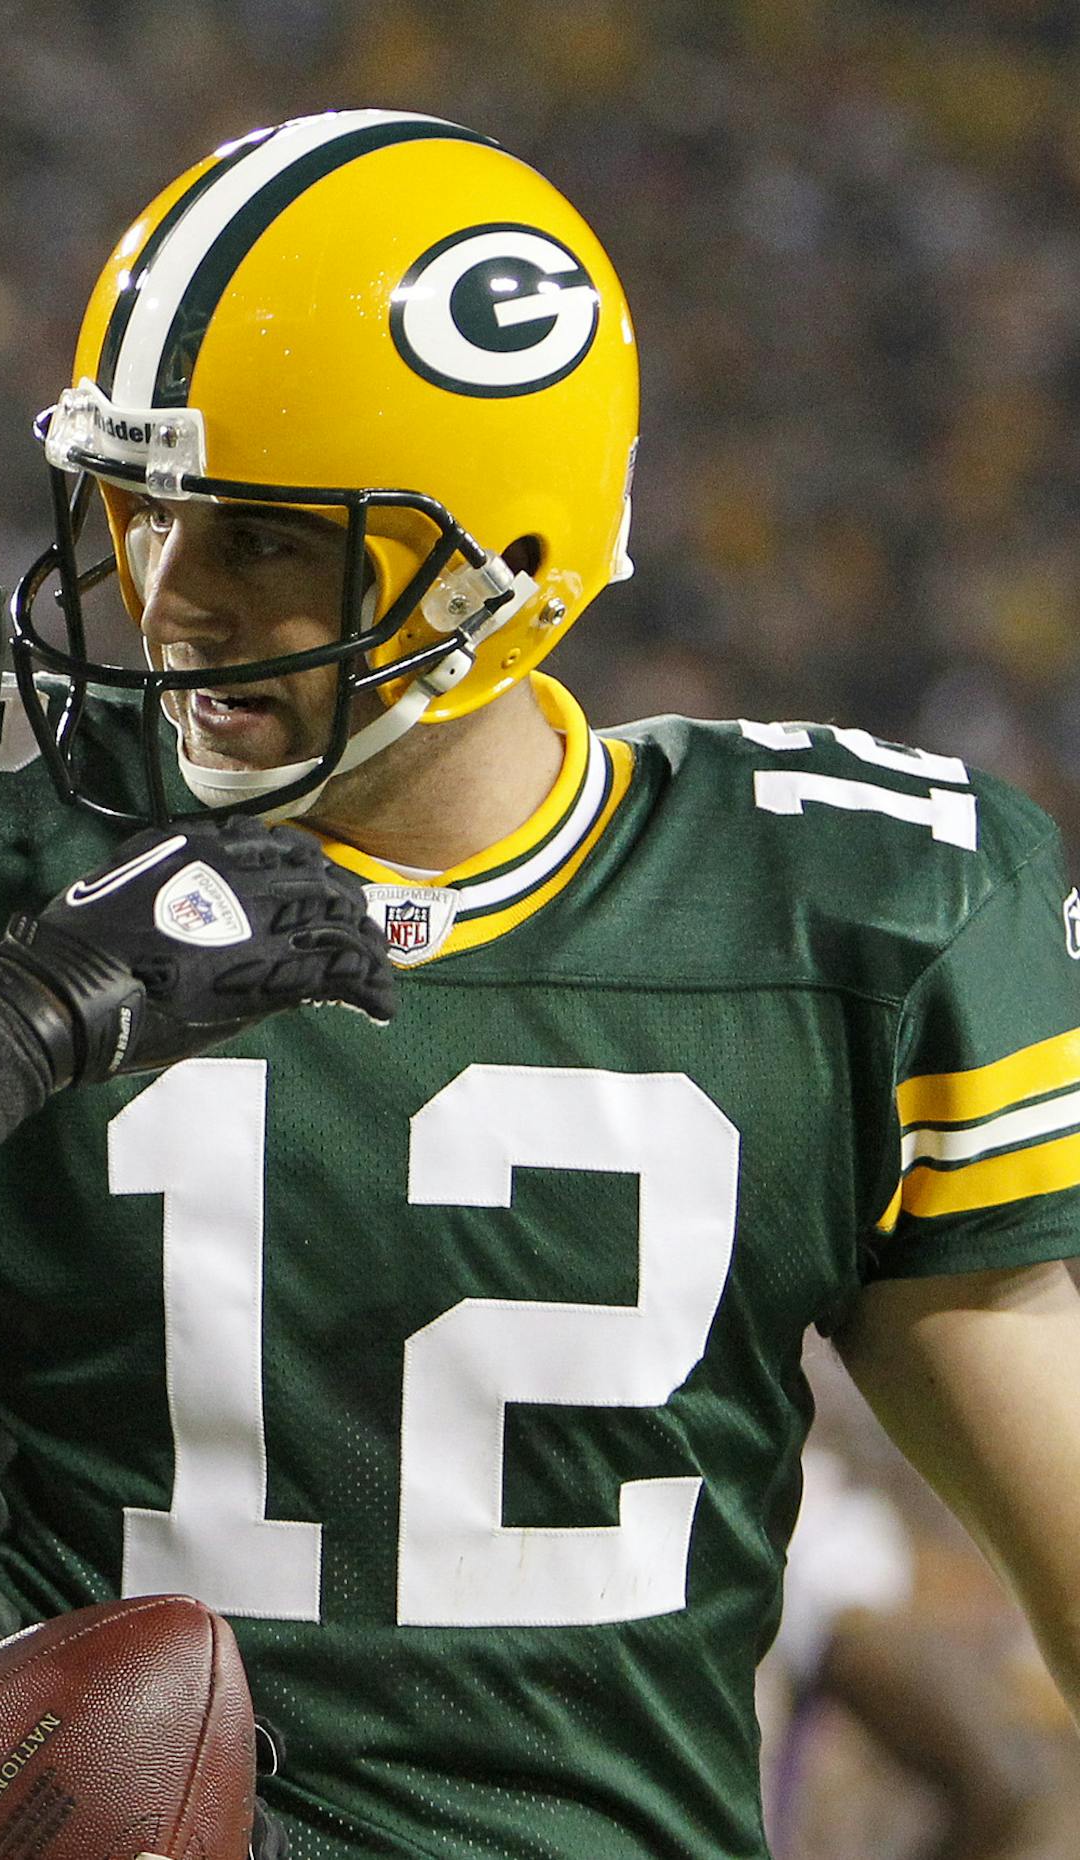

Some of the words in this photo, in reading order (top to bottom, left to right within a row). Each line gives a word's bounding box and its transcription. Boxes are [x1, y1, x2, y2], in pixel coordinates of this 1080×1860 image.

[402, 230, 596, 387] G
[94, 405, 156, 444] Riddel
[171, 898, 203, 930] NFL
[368, 887, 449, 903] EQUIPMENT
[385, 920, 425, 948] NFL
[117, 1006, 132, 1050] SUPER
[107, 1057, 741, 1626] 12
